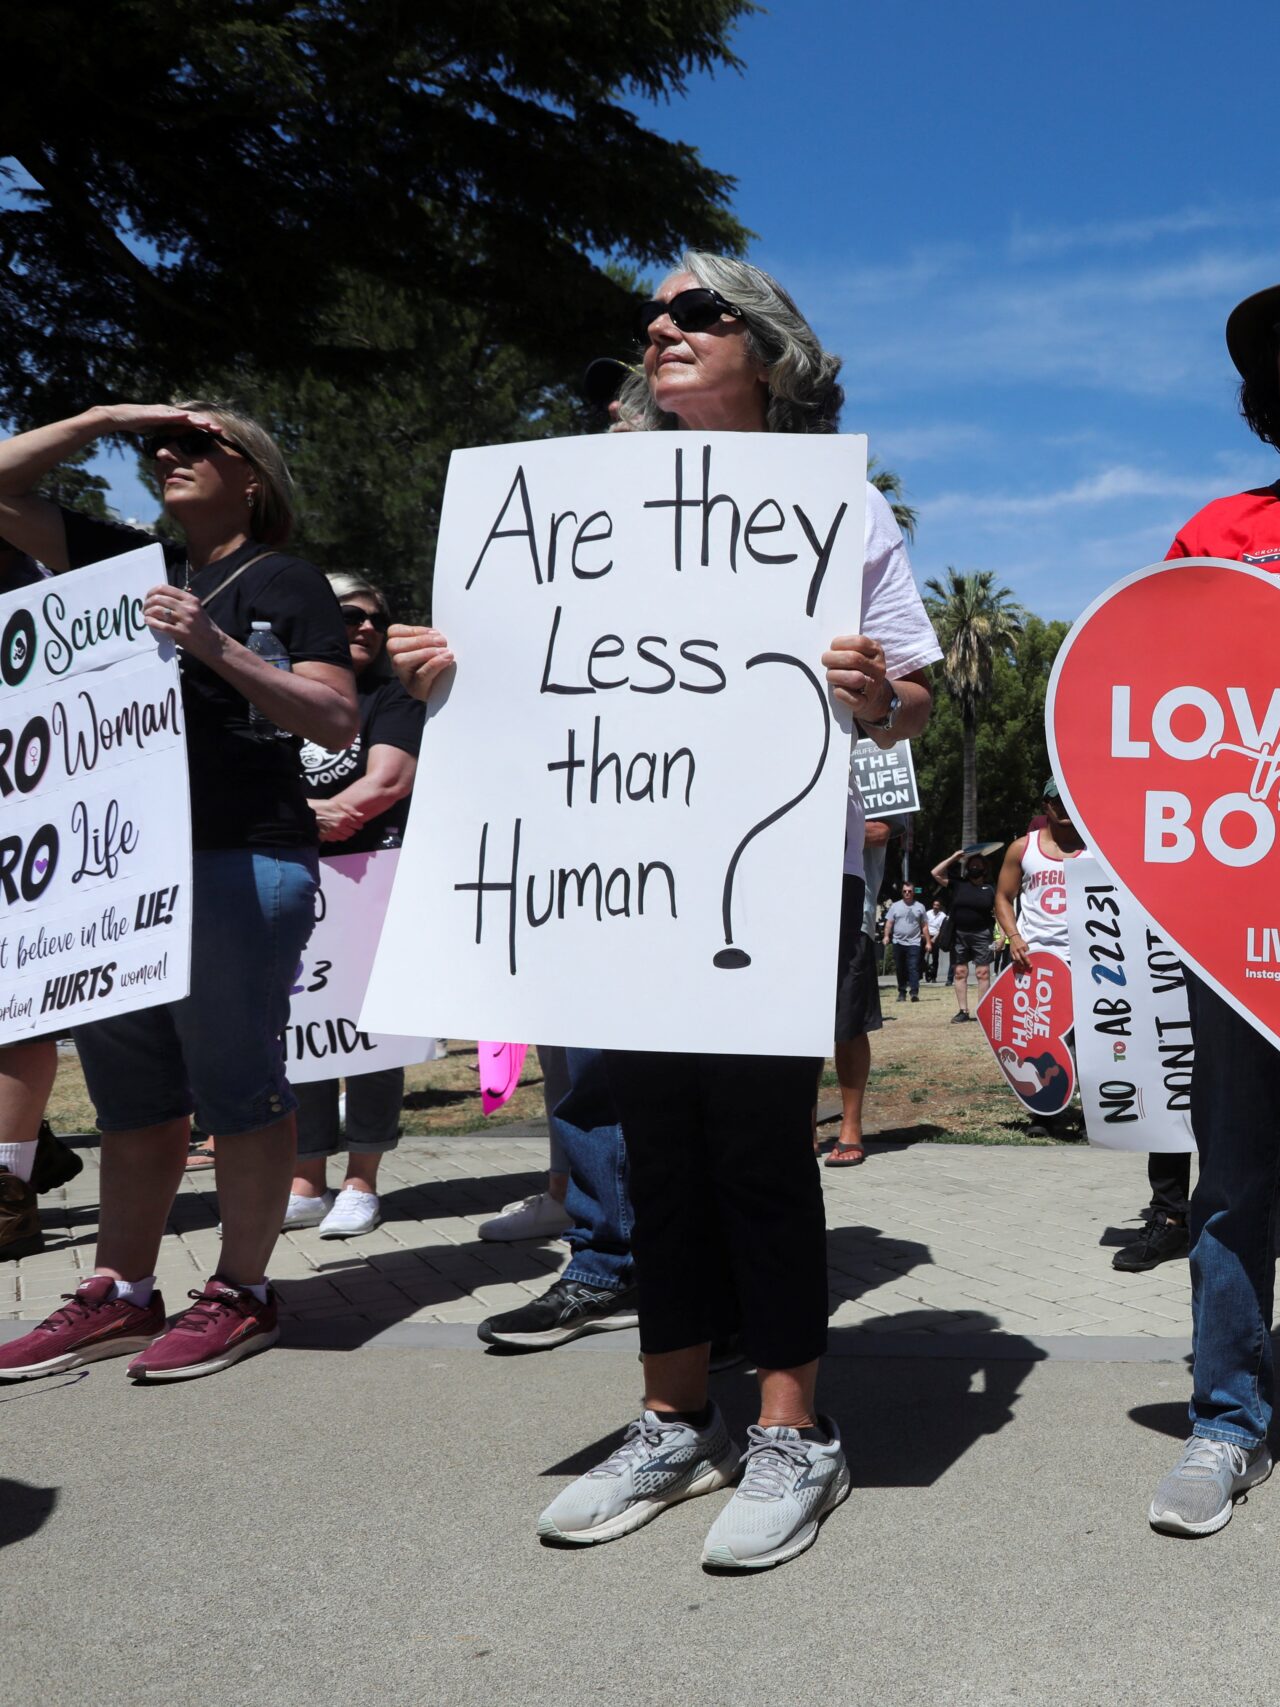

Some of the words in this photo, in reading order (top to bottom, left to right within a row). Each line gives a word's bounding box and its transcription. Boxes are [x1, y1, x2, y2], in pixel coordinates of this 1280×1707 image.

[465, 464, 614, 590] Are
[643, 443, 848, 617] they
[0, 608, 36, 687] O
[42, 593, 147, 675] Scienc
[540, 605, 727, 694] Less
[52, 687, 181, 776] Woman
[548, 714, 697, 807] than
[854, 752, 899, 771] THE
[306, 757, 358, 786] VOICE
[855, 767, 909, 791] LIFE
[71, 799, 139, 884] Life
[17, 926, 76, 969] believe
[80, 921, 97, 948] in
[101, 906, 130, 942] the
[134, 884, 179, 931] LIE!
[454, 817, 678, 975] Human
[1084, 885, 1127, 987] 2223!
[1146, 928, 1186, 993] VOT
[0, 994, 33, 1022] rtion
[39, 961, 117, 1015] HURTS
[120, 951, 168, 987] women!
[1012, 973, 1031, 1048] BOTH
[1033, 967, 1054, 1038] LOVE
[1093, 998, 1132, 1036] AB
[1113, 1041, 1126, 1062] TO
[1099, 1080, 1139, 1124] NO
